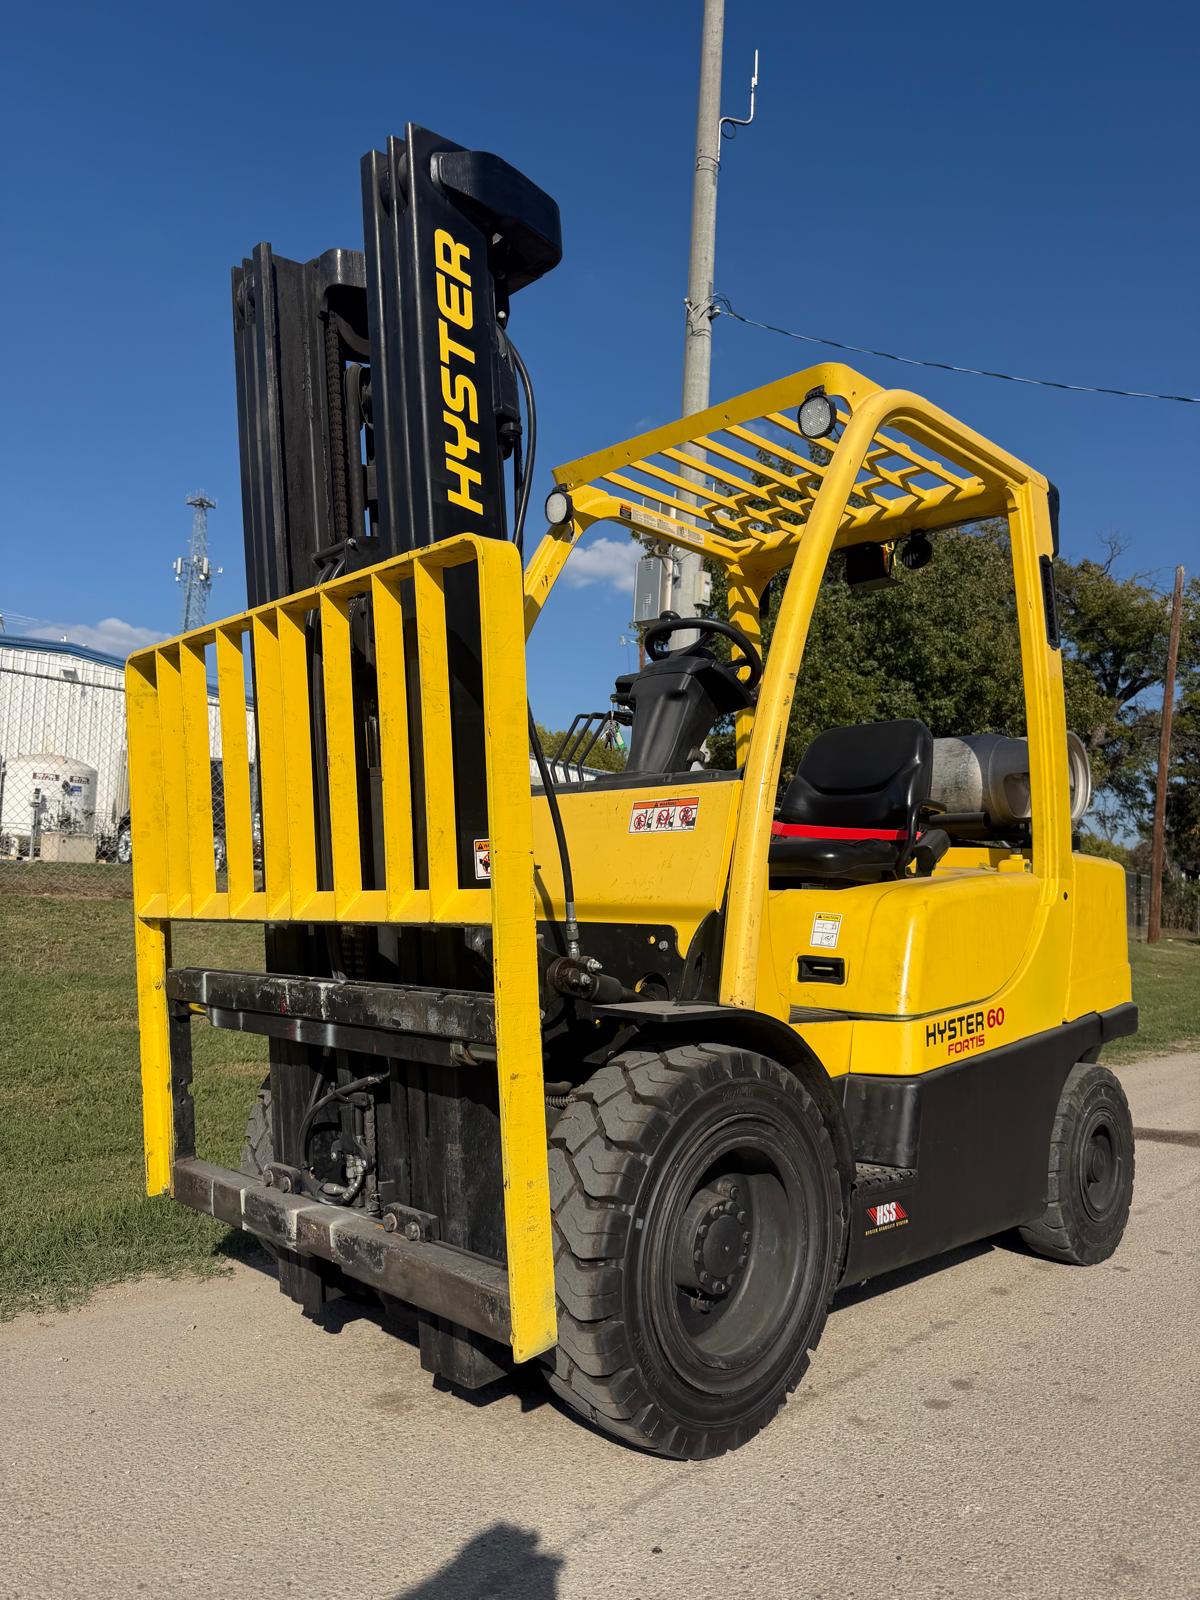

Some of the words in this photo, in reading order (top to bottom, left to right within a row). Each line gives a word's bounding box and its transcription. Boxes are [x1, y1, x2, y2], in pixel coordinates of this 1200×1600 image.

[434, 228, 484, 516] HYSTER
[926, 1011, 985, 1048] HYSTER
[986, 1007, 1005, 1029] 60
[947, 1034, 985, 1057] FORTIS
[876, 1201, 897, 1226] HSS
